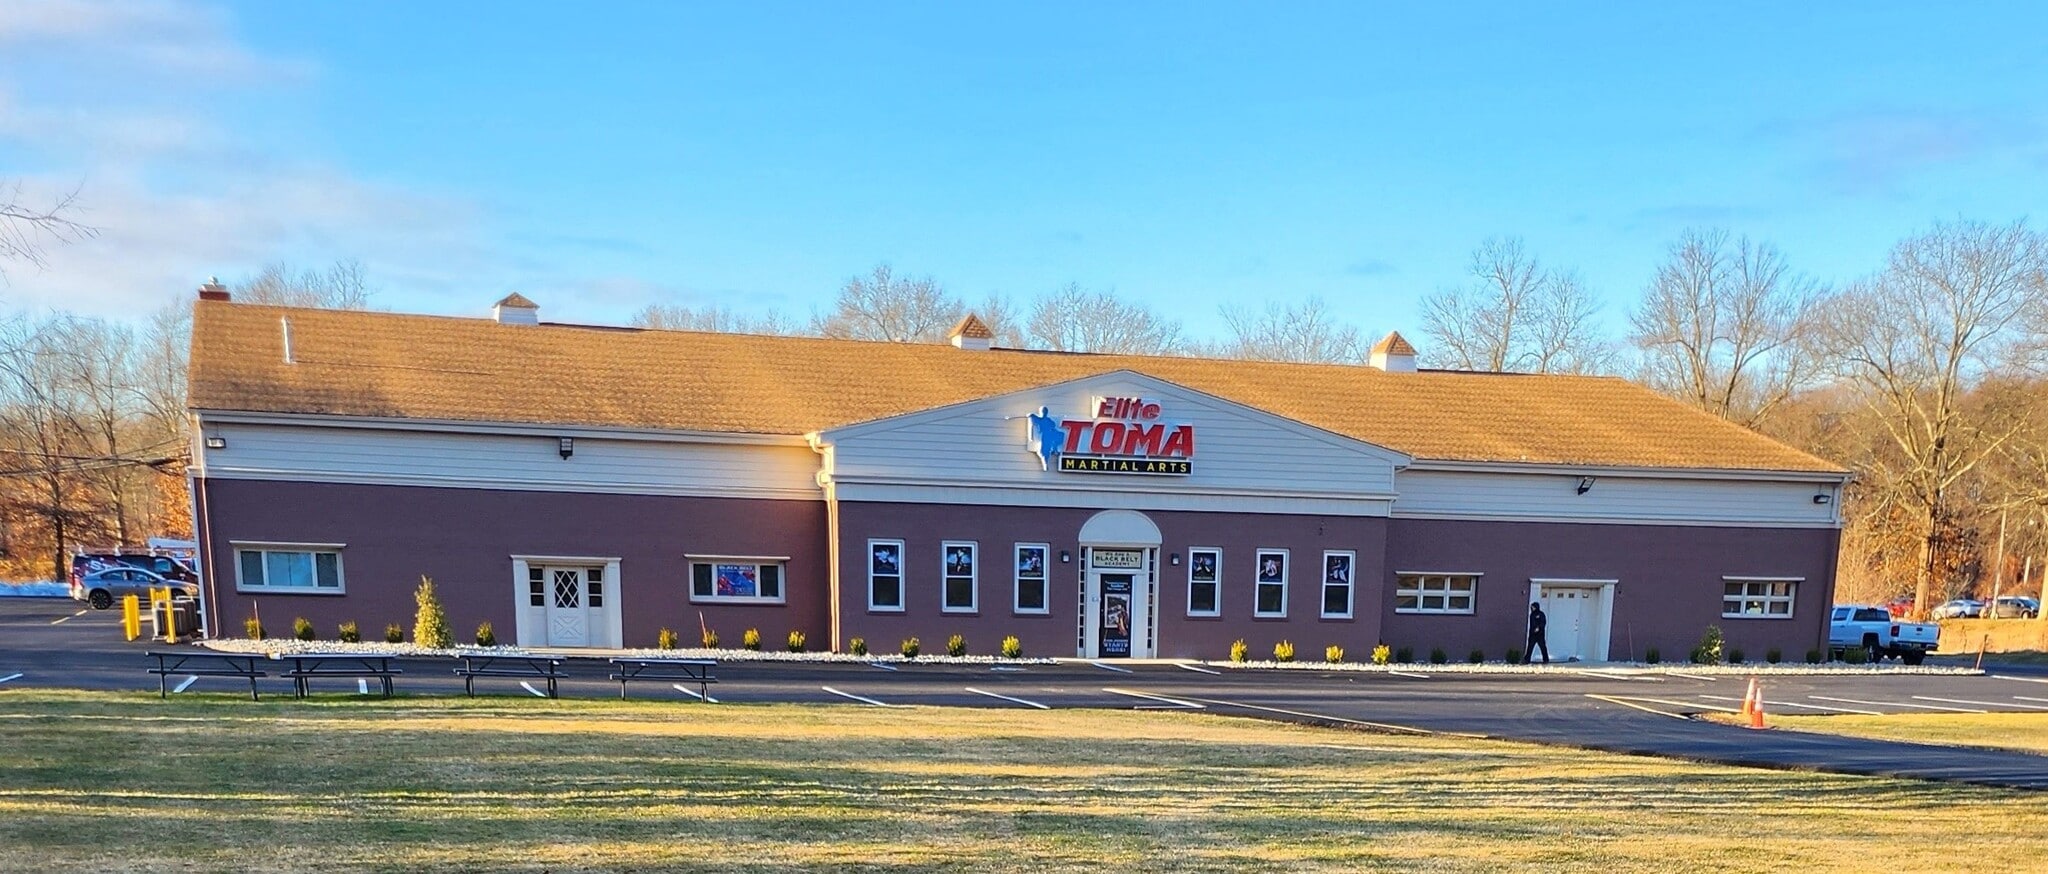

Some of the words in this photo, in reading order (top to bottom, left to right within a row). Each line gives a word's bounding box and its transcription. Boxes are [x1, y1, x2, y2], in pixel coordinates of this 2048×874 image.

[1097, 396, 1161, 420] Elite
[1061, 420, 1194, 457] TOMA
[1065, 459, 1139, 472] MARTIAL
[1146, 461, 1187, 473] ARTS
